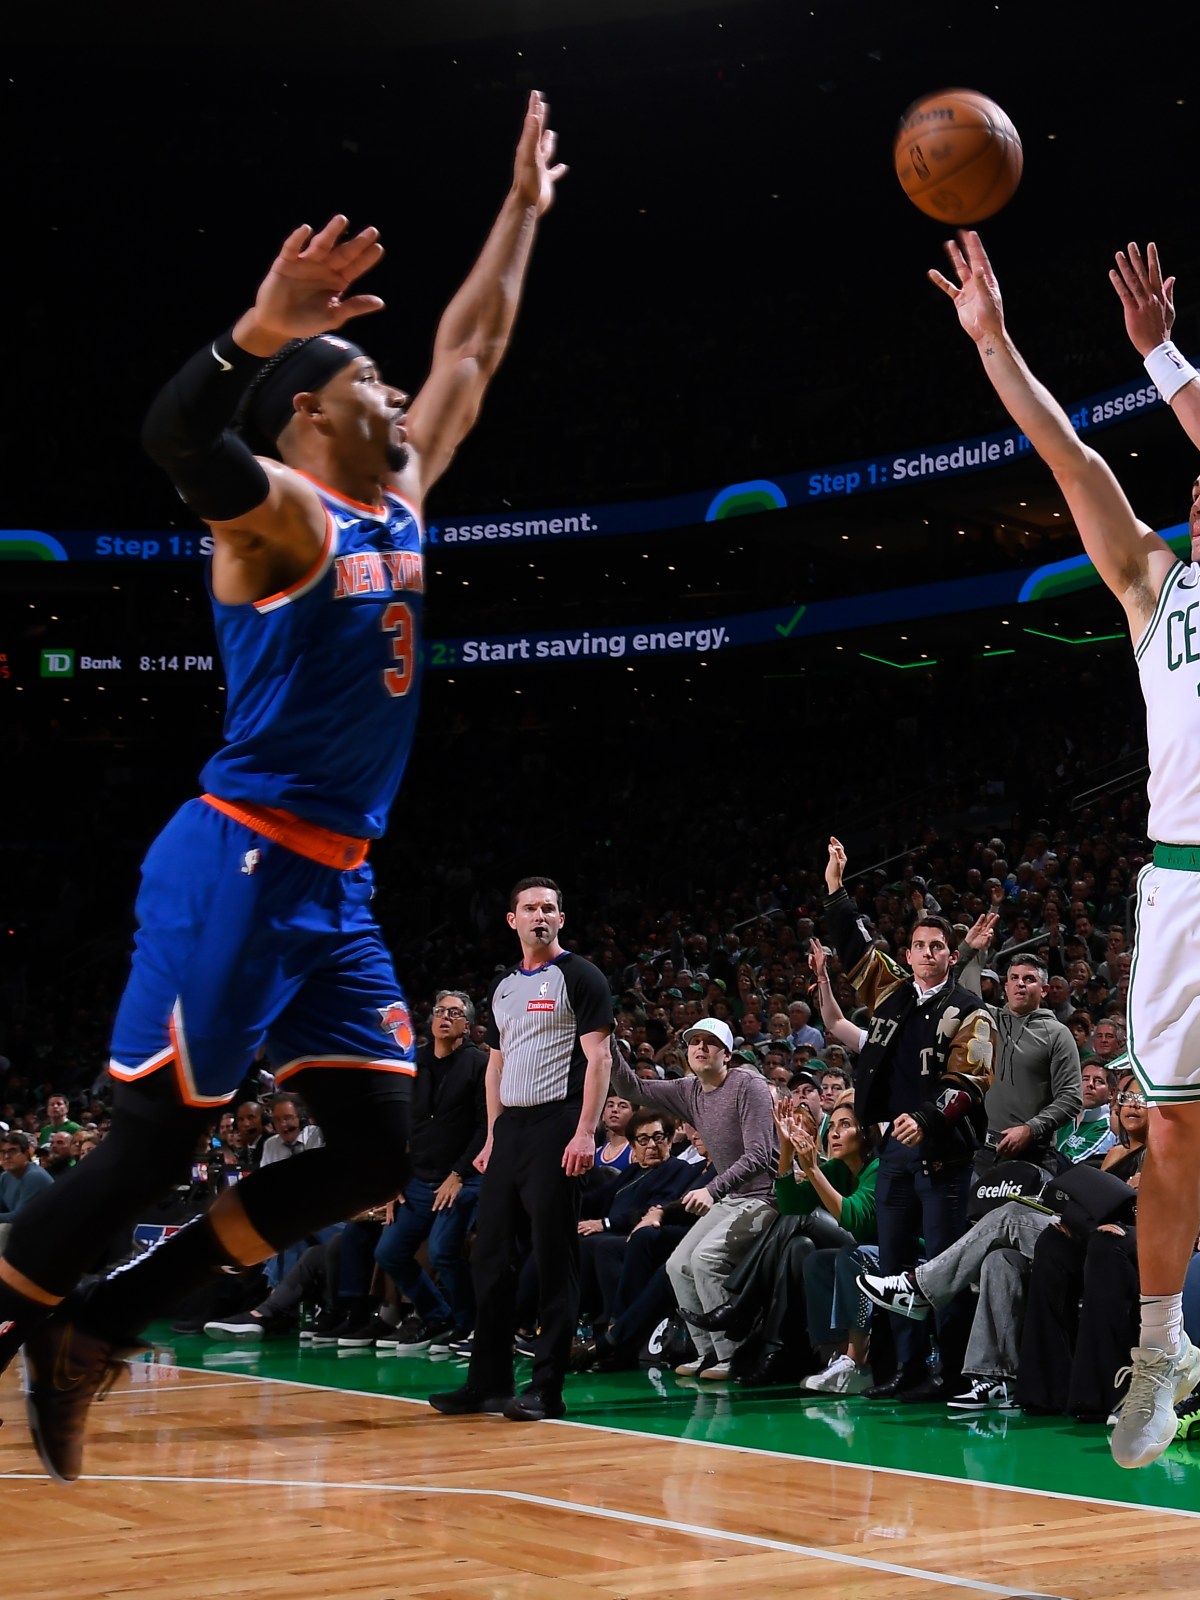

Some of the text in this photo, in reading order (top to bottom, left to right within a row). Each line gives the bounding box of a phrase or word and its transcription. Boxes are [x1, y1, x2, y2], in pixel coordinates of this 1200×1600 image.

[808, 474, 860, 495] Step
[867, 464, 887, 484] 1:
[893, 441, 1000, 480] Schedule
[1004, 438, 1015, 456] a
[443, 513, 598, 543] assessment.
[96, 536, 160, 559] Step
[169, 536, 192, 555] 1:
[335, 552, 384, 598] NEW
[381, 602, 414, 697] 3
[431, 627, 730, 665] 2: Start saving energy.
[44, 653, 122, 672] TD Bank
[139, 656, 213, 671] 8:14 PM
[527, 1001, 554, 1011] Emirates
[977, 1180, 1023, 1199] @celtics
